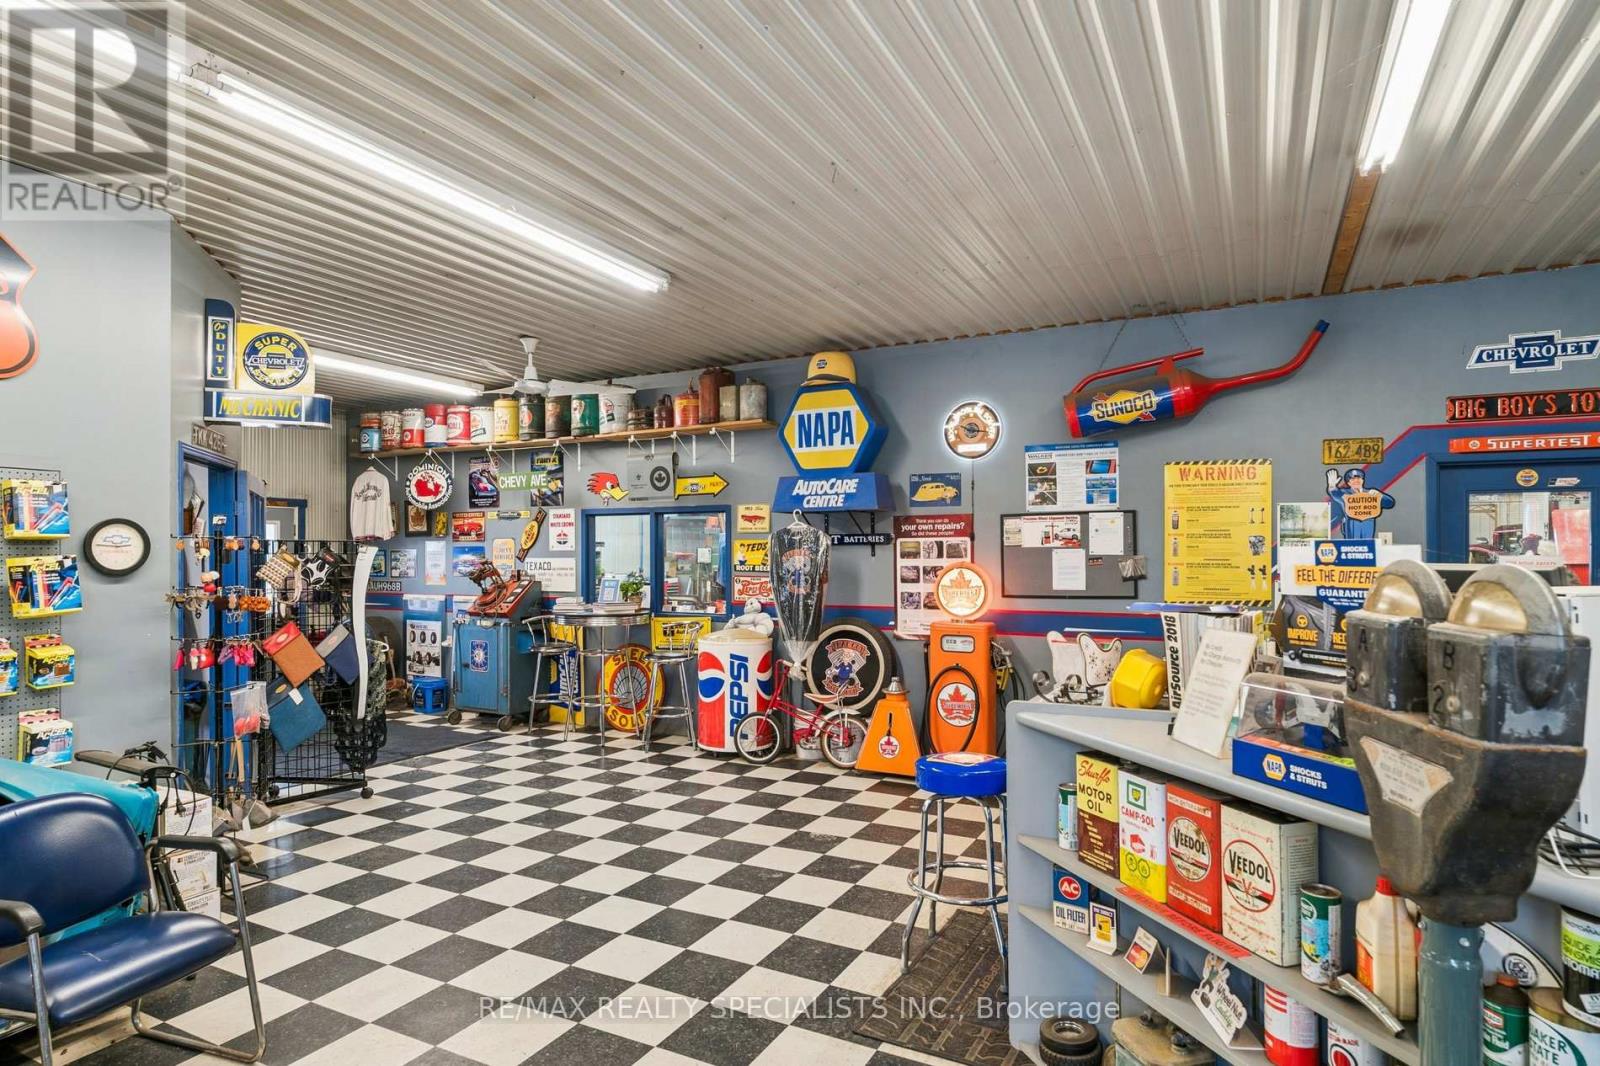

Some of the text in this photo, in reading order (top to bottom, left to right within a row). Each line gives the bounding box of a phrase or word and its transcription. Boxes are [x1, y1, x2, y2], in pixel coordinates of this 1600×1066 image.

[254, 336, 298, 351] SUPER
[1481, 341, 1591, 362] CHEVROLET
[249, 356, 304, 367] CHEVROLET
[218, 396, 301, 418] MECHANIC
[1095, 392, 1154, 420] SUNOCO
[1455, 391, 1600, 419] BIG BOY'S TO
[796, 409, 855, 449] NAPA
[1487, 433, 1591, 450] SUPERTEST
[407, 463, 451, 480] DOMINION
[1178, 465, 1257, 481] WARNING
[499, 473, 547, 489] CHEVY AVE
[792, 478, 858, 496] AUTOCARE
[802, 494, 846, 509] CENTRE
[1347, 496, 1378, 504] CAUTION
[901, 524, 916, 532] your
[935, 522, 965, 531] repairs?
[843, 535, 885, 544] BATTERIES
[1340, 545, 1369, 553] SHOCKS
[1347, 552, 1374, 560] STRUTS
[526, 561, 552, 571] TEXACO
[735, 564, 753, 572] ROOT
[1296, 568, 1318, 583] FEEL
[1318, 568, 1336, 583] THE
[1287, 628, 1319, 641] IMPROVE
[1164, 614, 1183, 708] AirSource 2018
[730, 653, 749, 741] PEPSI
[1265, 759, 1323, 780] NAPA SHOCKS
[1289, 773, 1328, 790] & STRUTS
[1078, 782, 1112, 805] MOTOR
[1086, 799, 1104, 814] OIL
[1121, 806, 1156, 828] CAMP-SOL
[1173, 826, 1207, 856] VEEDOL
[1228, 848, 1271, 884] VEEDOL
[1061, 881, 1079, 895] AC
[1055, 905, 1066, 919] OIL
[1066, 908, 1086, 924] FILTER
[1529, 1023, 1568, 1054] UAKER
